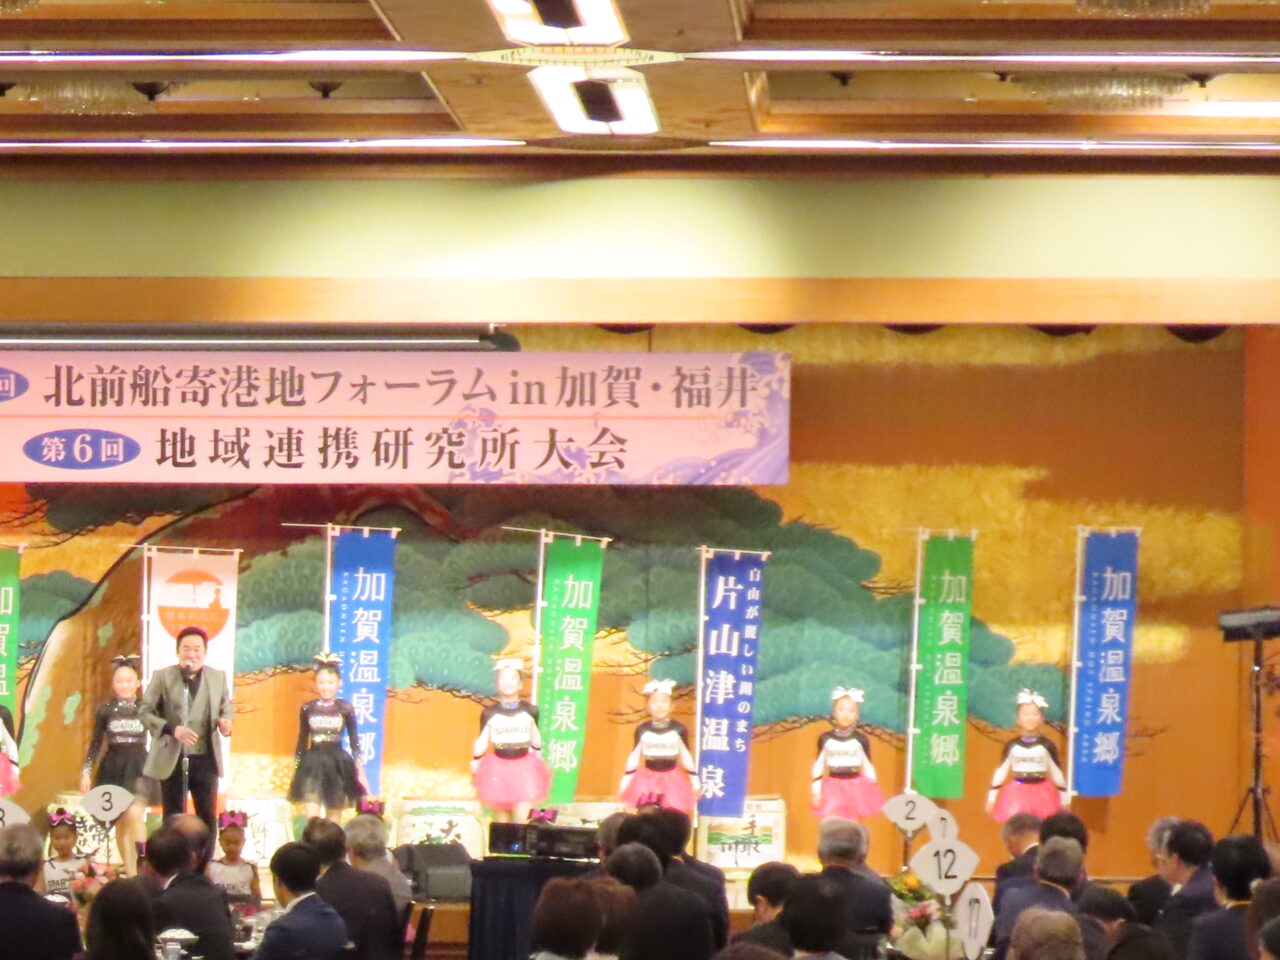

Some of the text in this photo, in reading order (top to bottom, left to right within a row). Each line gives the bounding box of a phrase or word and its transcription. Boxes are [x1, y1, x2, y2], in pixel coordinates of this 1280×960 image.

[40, 426, 629, 471] 第6回 地域連携研究所大会
[548, 574, 595, 773] 加賀温泉郷
[698, 574, 744, 799] 片山津温泉
[929, 569, 968, 767] 加賀温泉郷
[1092, 566, 1132, 766] 加賀温泉郷
[100, 791, 114, 812] 3
[904, 800, 917, 821] 2
[932, 848, 958, 881] 12
